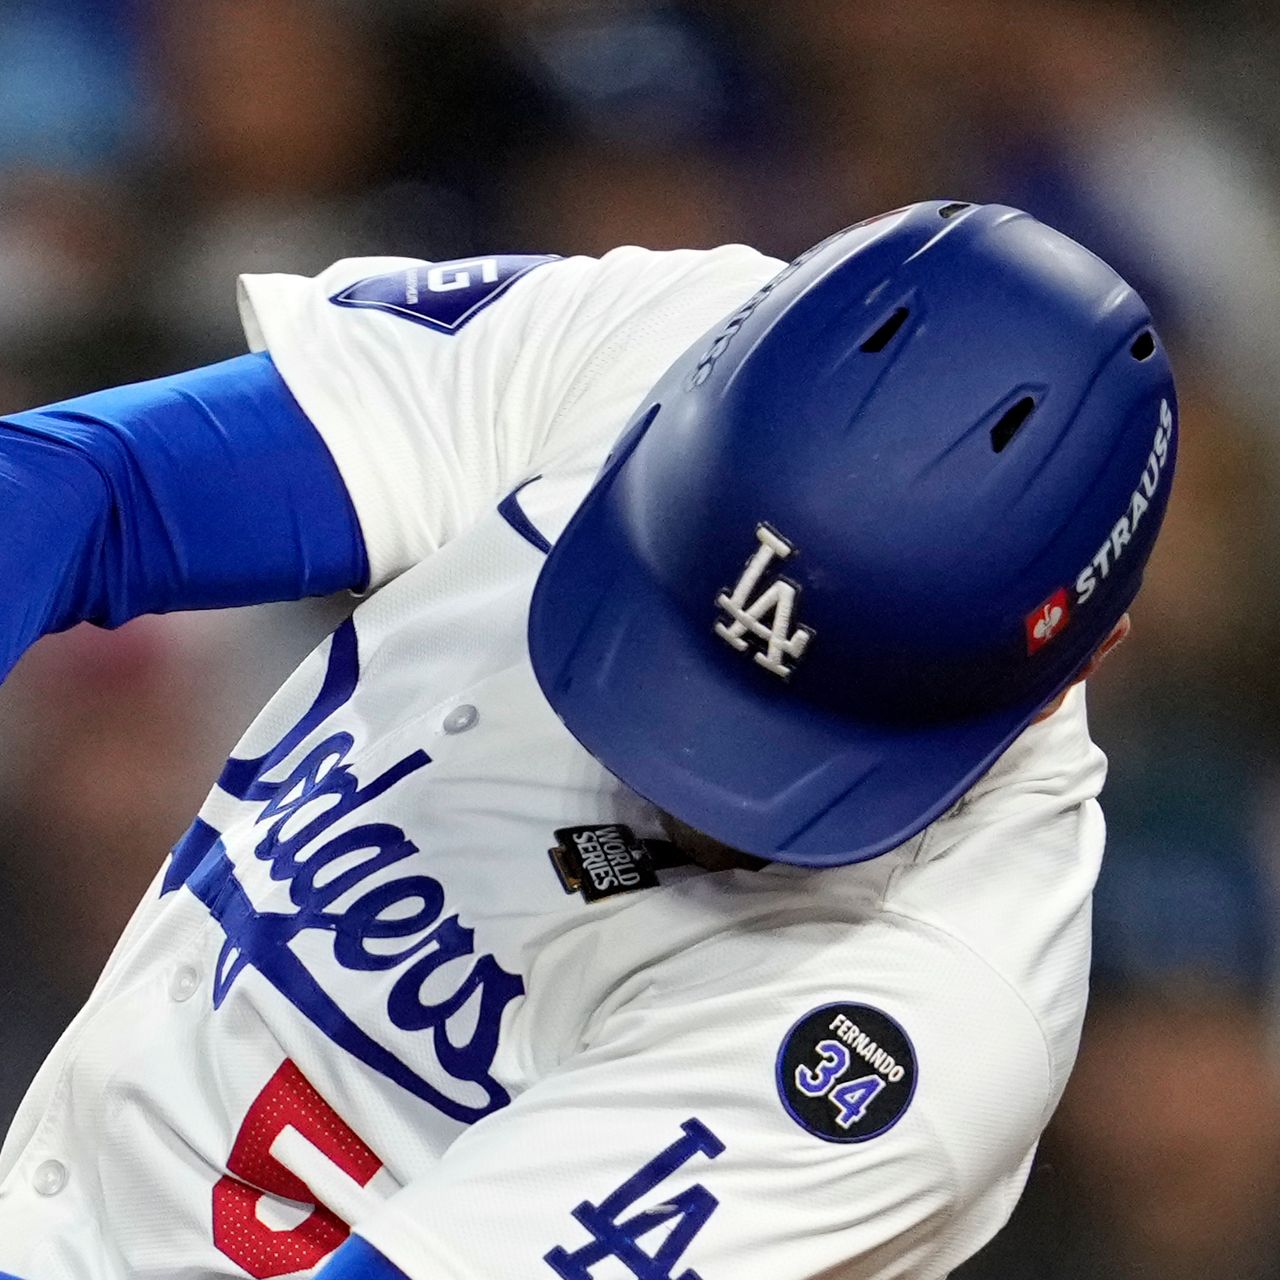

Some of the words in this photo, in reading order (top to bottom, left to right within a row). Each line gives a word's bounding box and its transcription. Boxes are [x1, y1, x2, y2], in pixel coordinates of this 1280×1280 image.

[1075, 398, 1173, 604] STRAUSS
[714, 526, 811, 678] LA
[159, 612, 526, 1125] Dodgers
[572, 831, 619, 891] SERIES
[595, 826, 641, 886] WORLD
[795, 1039, 886, 1129] 34
[828, 1013, 905, 1082] FERNANDO
[212, 1057, 384, 1280] 5
